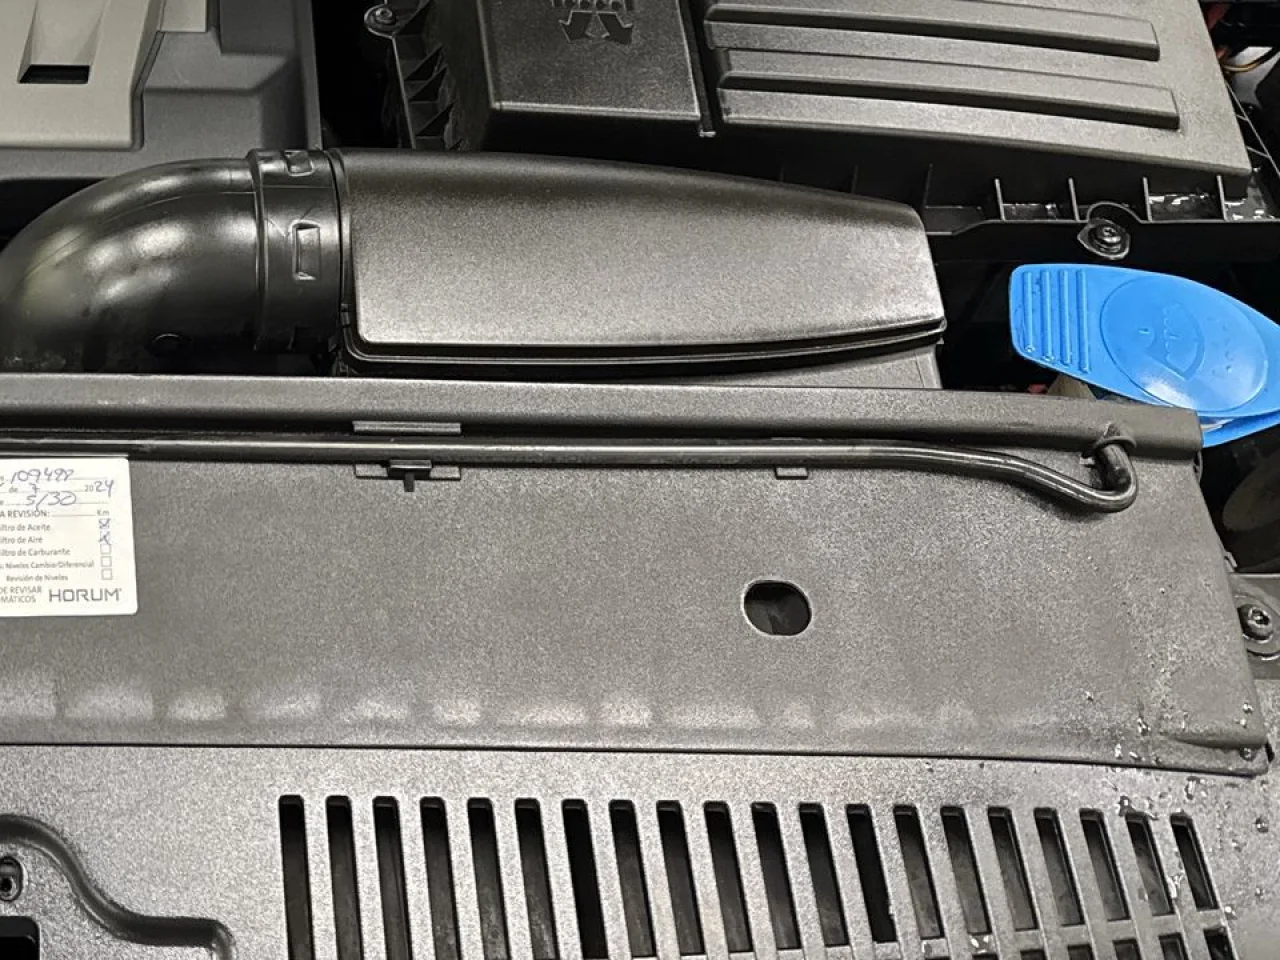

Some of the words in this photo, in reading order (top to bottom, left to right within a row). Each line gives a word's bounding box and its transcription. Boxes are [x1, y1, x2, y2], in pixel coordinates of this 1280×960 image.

[17, 524, 26, 532] de
[27, 524, 51, 532] Aceite
[17, 536, 26, 544] de
[27, 536, 43, 544] Aire
[17, 549, 26, 557] de
[27, 549, 70, 557] Carburante
[11, 586, 42, 594] REVISAR
[48, 588, 122, 602] HORUM
